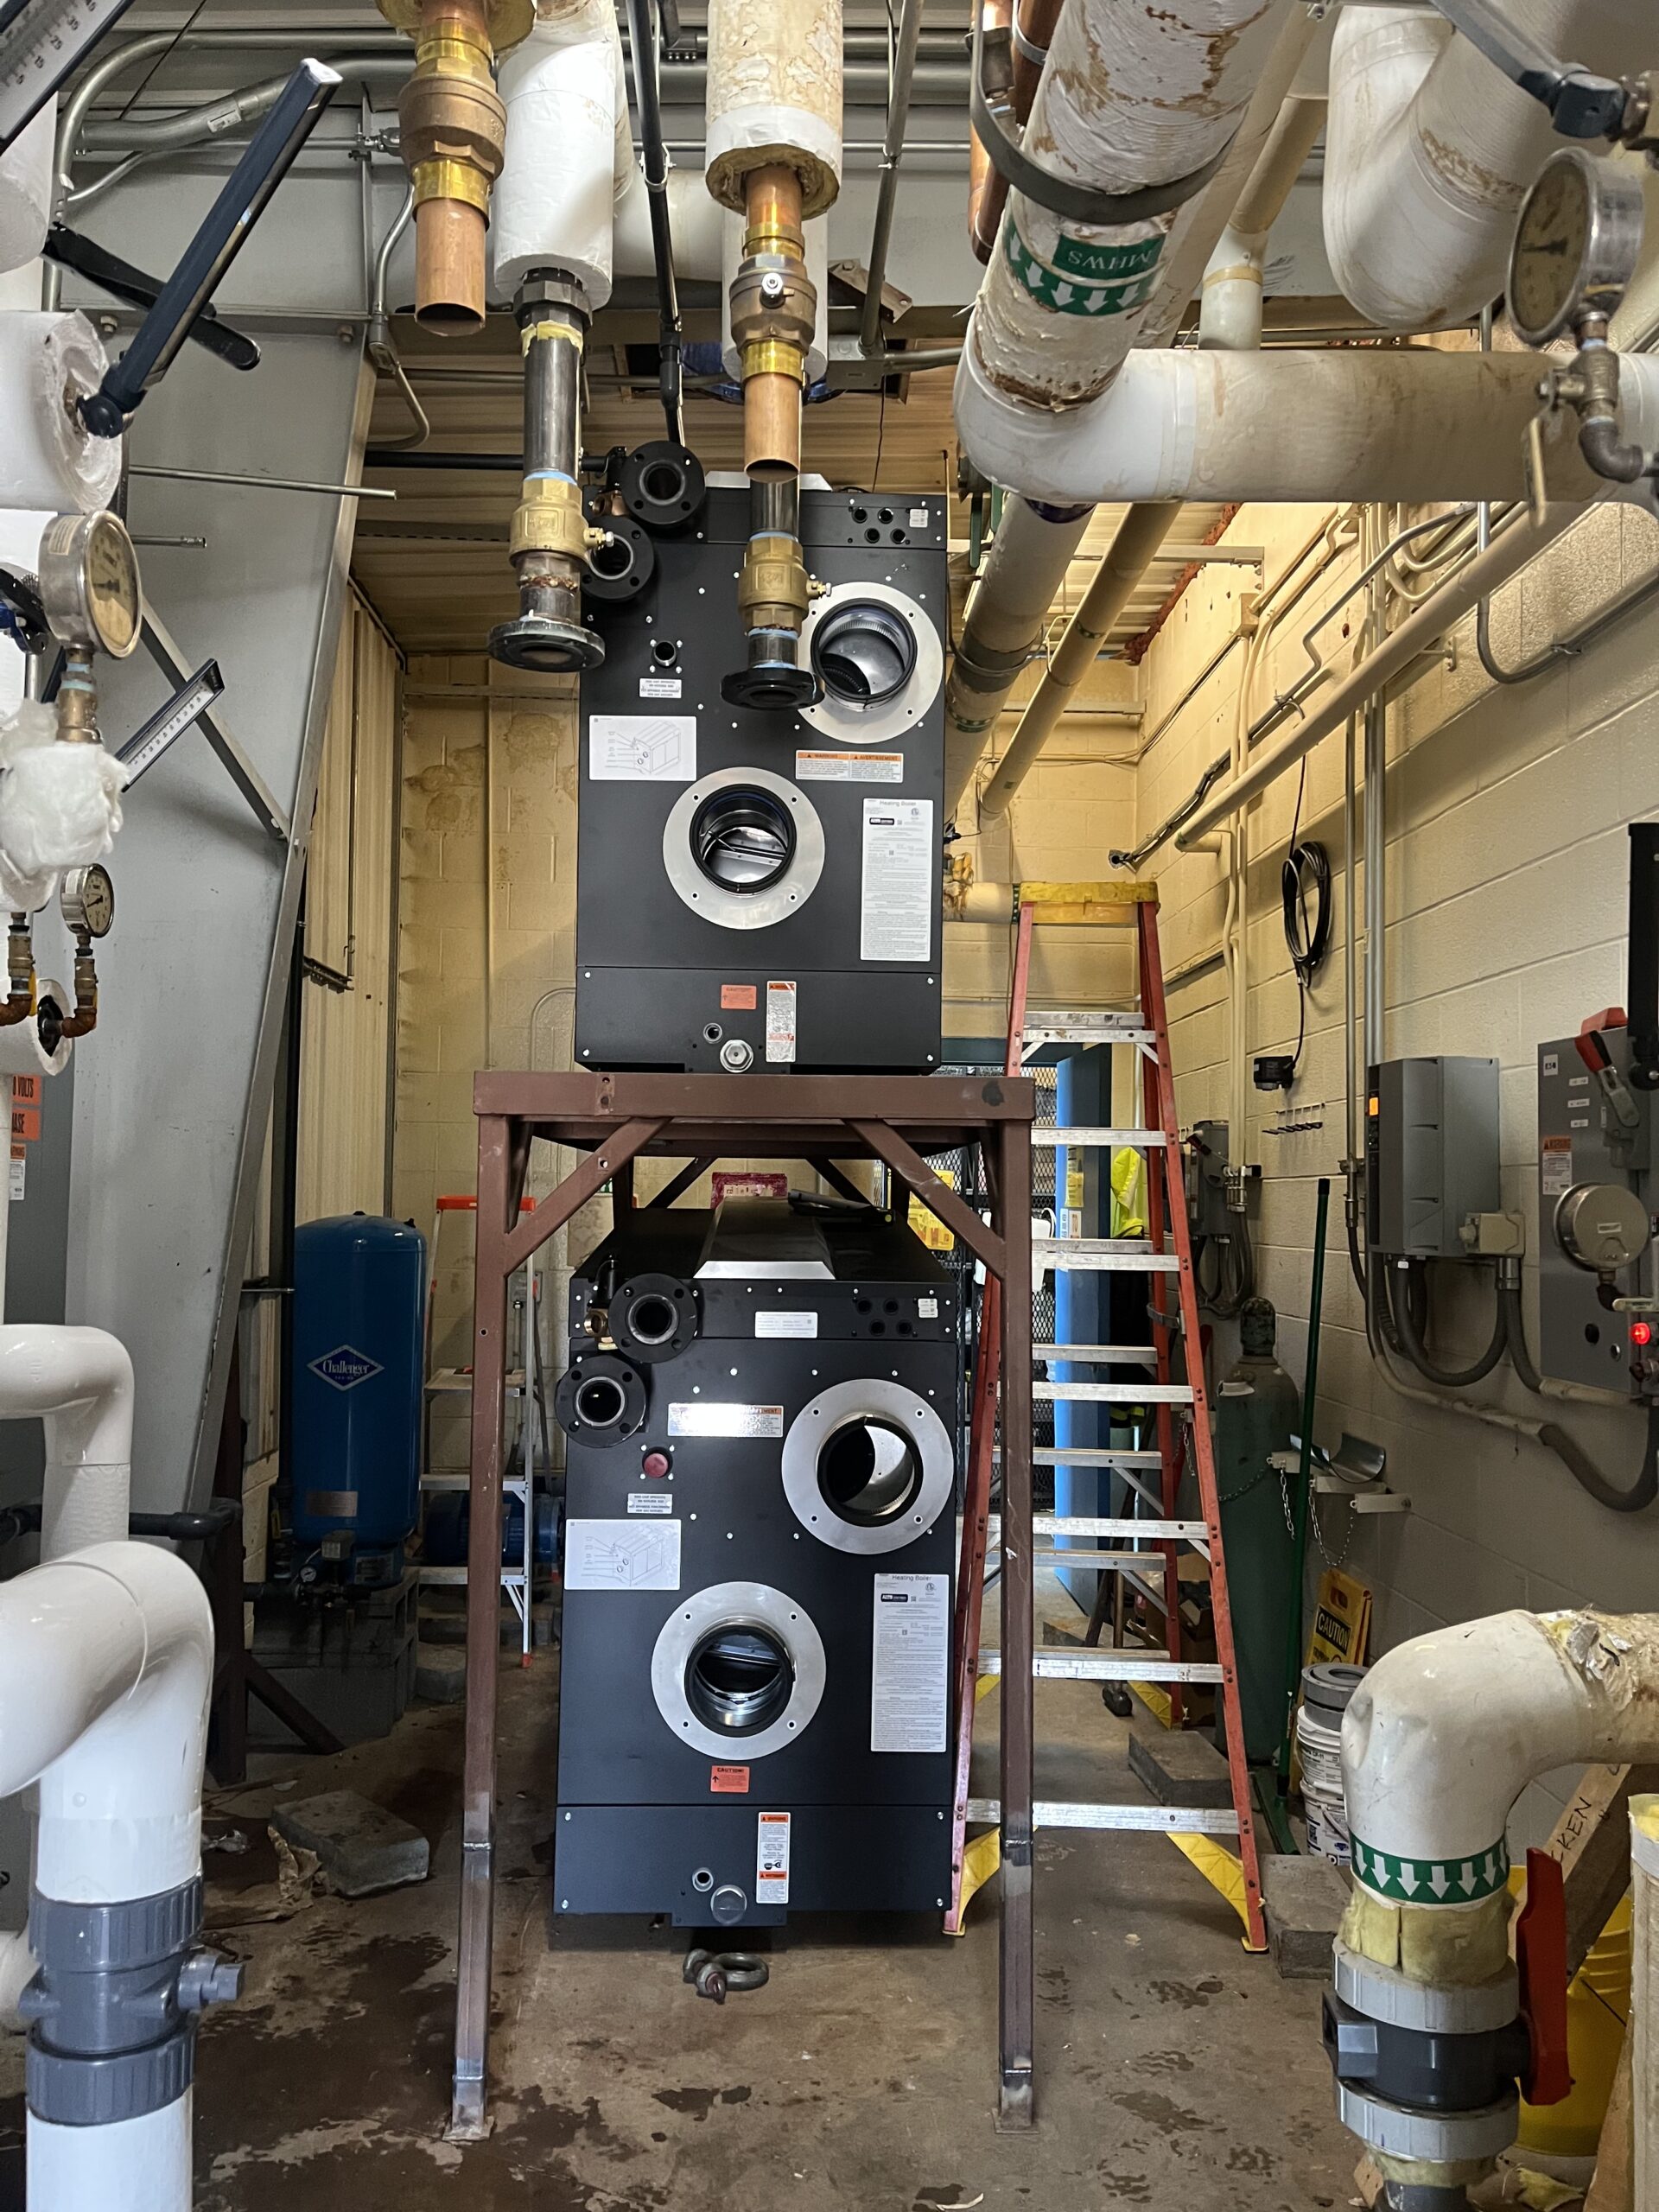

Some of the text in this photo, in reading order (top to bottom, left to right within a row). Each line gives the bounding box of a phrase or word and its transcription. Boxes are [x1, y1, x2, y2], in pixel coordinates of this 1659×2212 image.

[50, 35, 63, 50] 25
[35, 54, 44, 68] 15
[17, 1077, 35, 1098] VOLTS
[322, 1359, 370, 1377] Challenger
[1318, 1612, 1349, 1651] CAUTION
